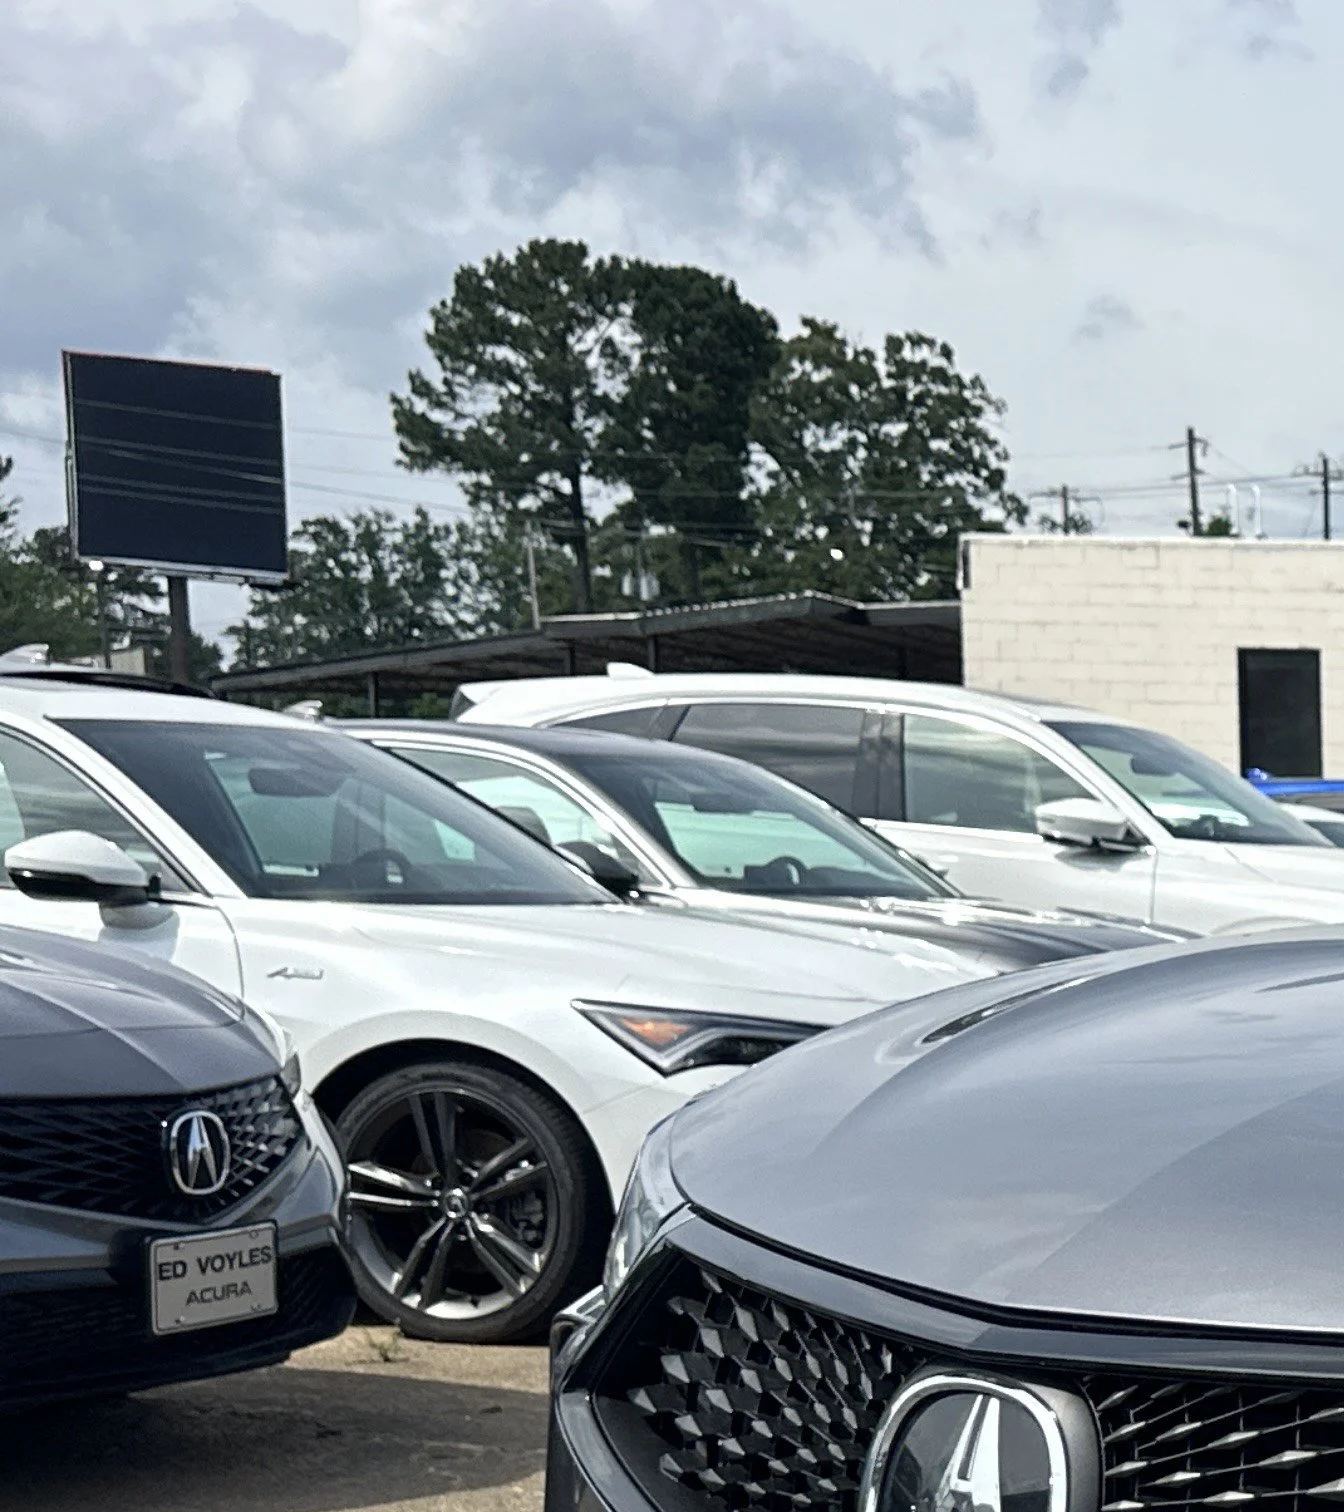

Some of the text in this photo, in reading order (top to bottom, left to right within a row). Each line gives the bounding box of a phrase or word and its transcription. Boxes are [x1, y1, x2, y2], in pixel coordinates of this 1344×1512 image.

[158, 1245, 272, 1281] ED VOYLES
[185, 1281, 252, 1306] ACURA
